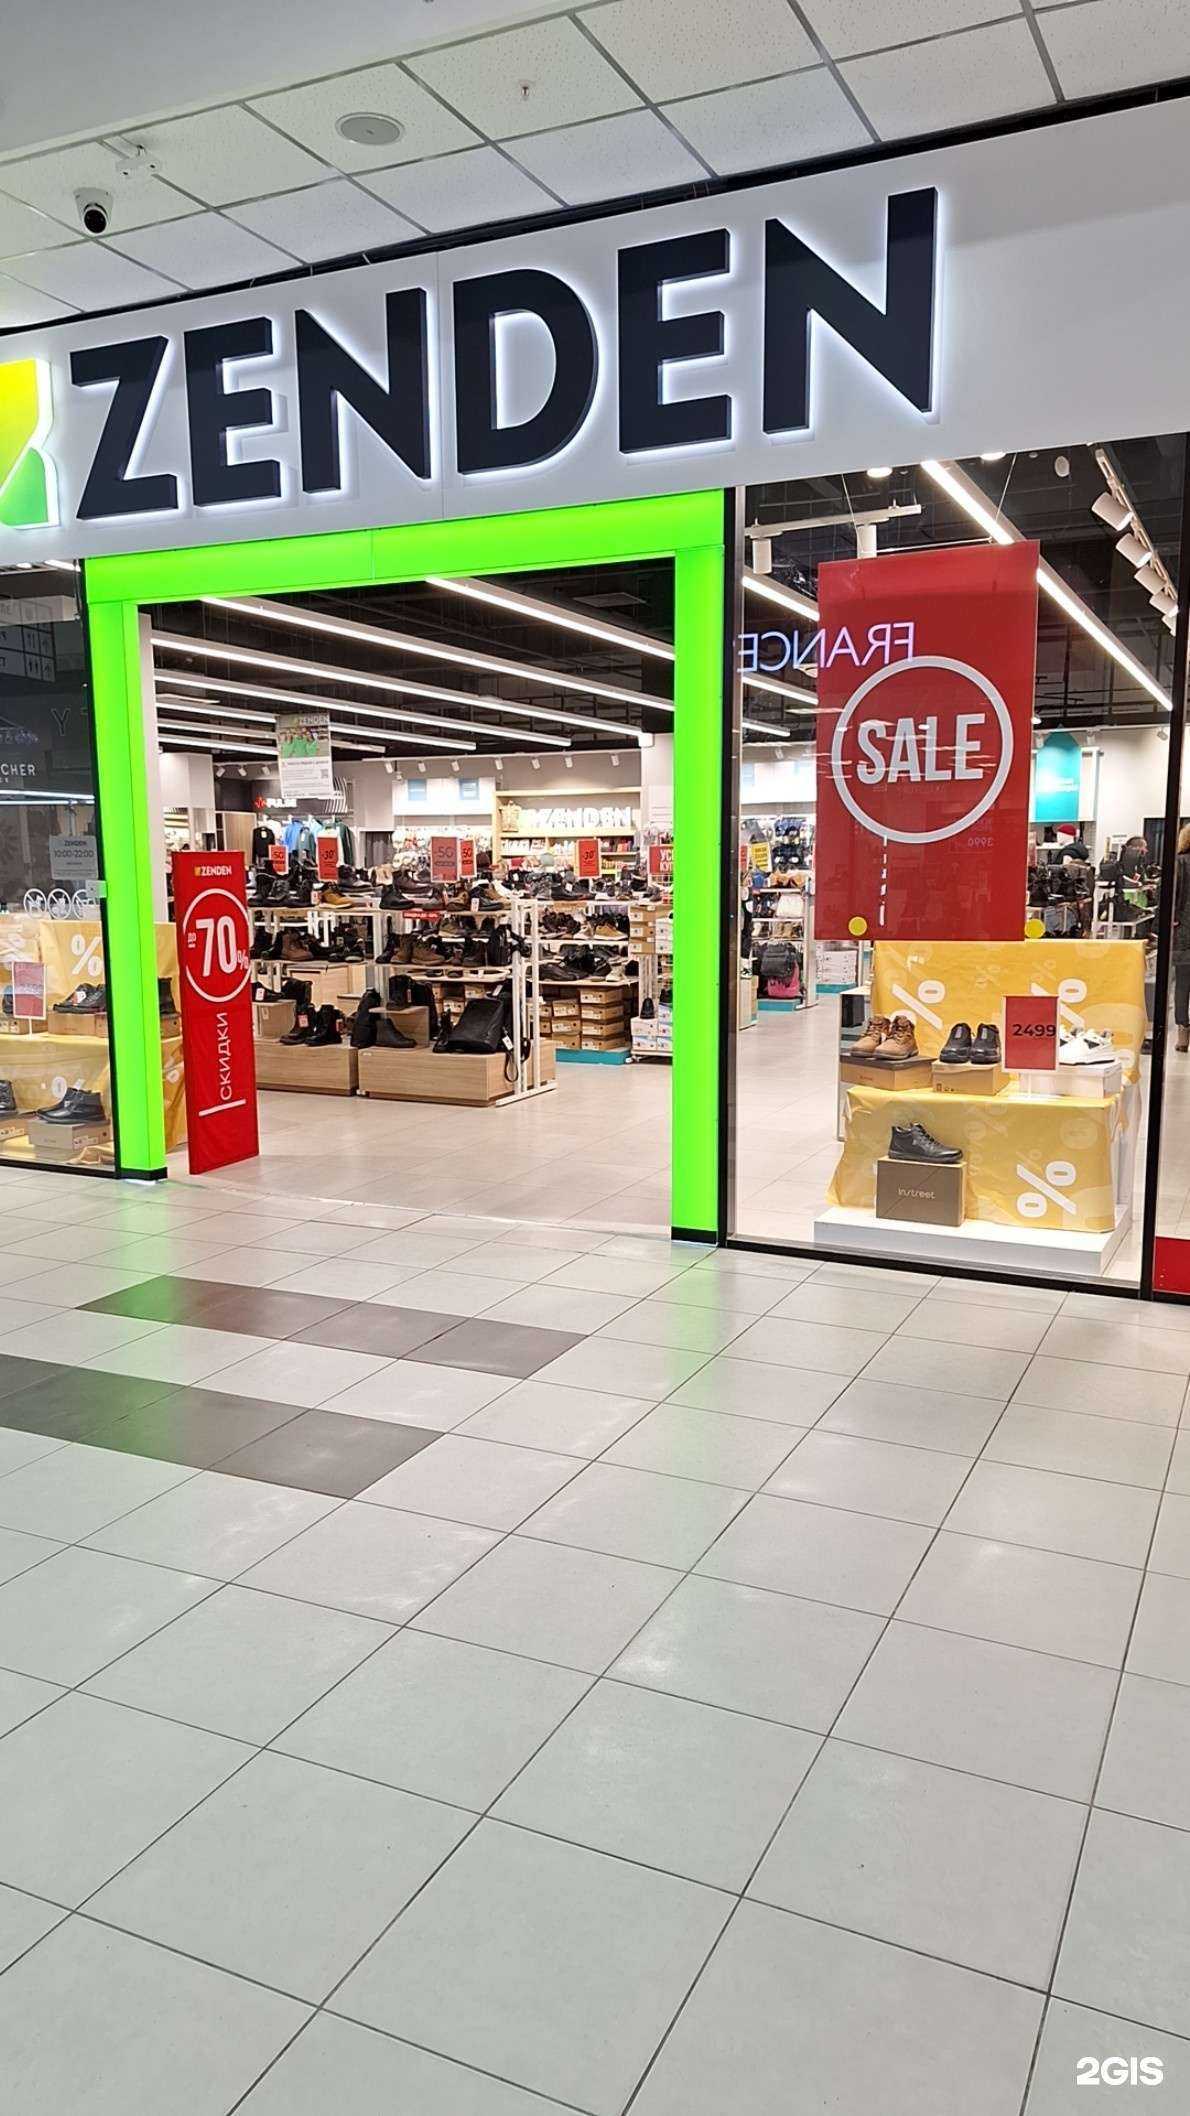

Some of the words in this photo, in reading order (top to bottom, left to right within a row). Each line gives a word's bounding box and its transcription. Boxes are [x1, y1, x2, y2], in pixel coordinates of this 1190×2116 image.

[70, 186, 938, 520] ZENDEN
[857, 713, 986, 785] SALE
[201, 866, 232, 876] ZENDEN
[217, 1012, 232, 1100] СКИДКИ
[1012, 1024, 1057, 1037] 2499
